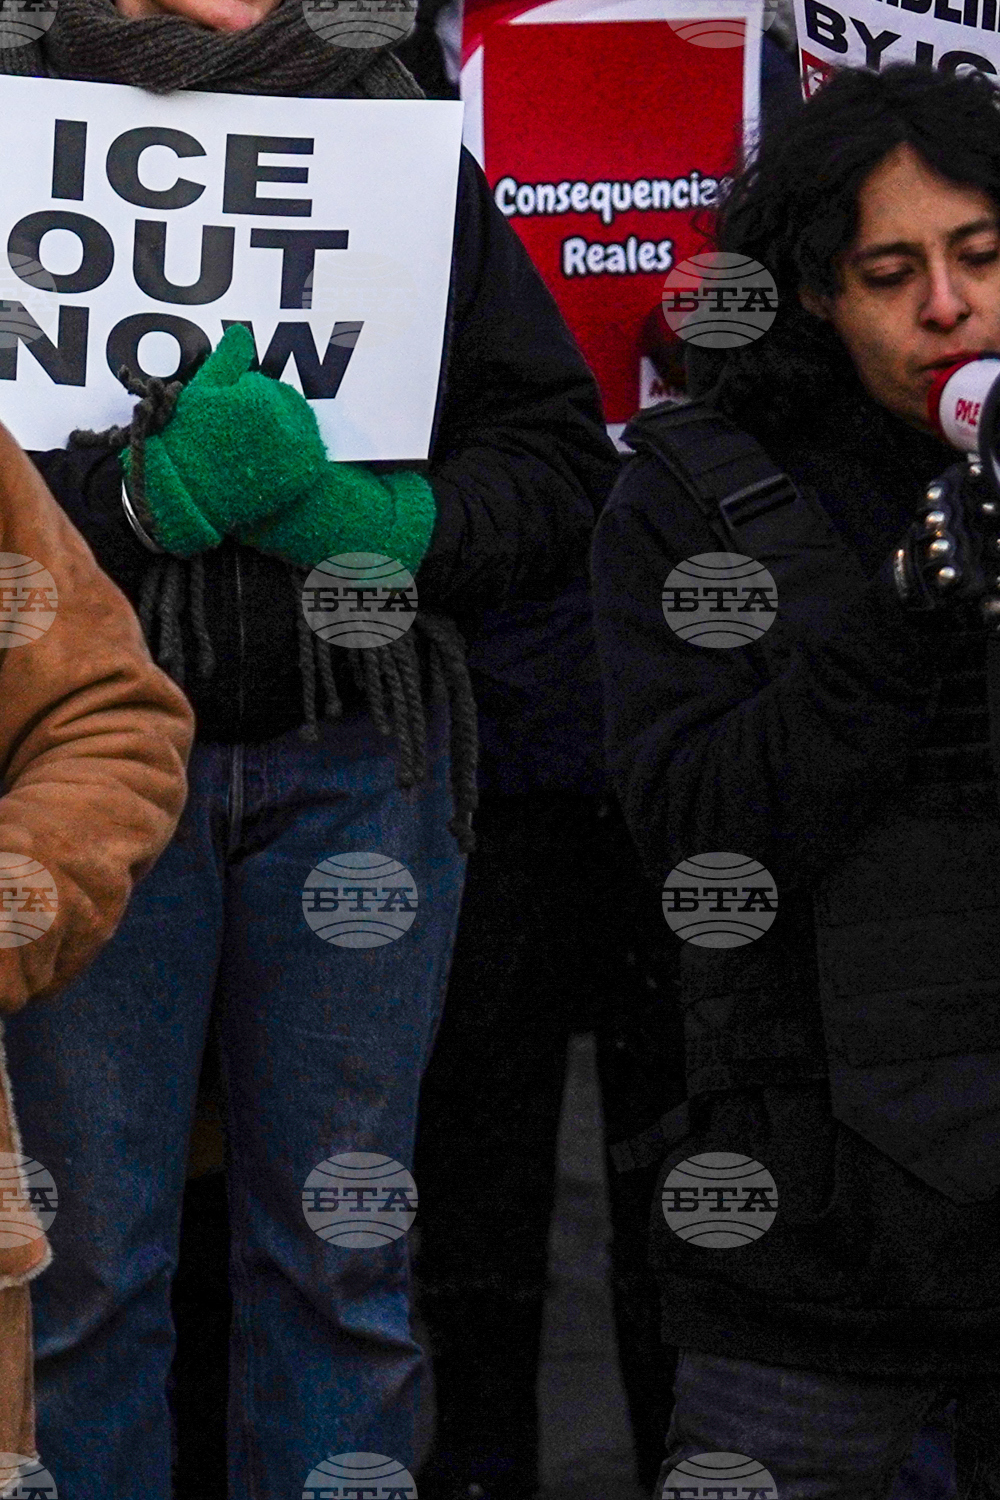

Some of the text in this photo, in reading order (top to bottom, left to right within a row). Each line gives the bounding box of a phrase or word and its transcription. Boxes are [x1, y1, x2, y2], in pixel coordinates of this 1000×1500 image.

[50, 118, 315, 218] ICE
[6, 209, 350, 311] OUT
[562, 235, 674, 276] Reales
